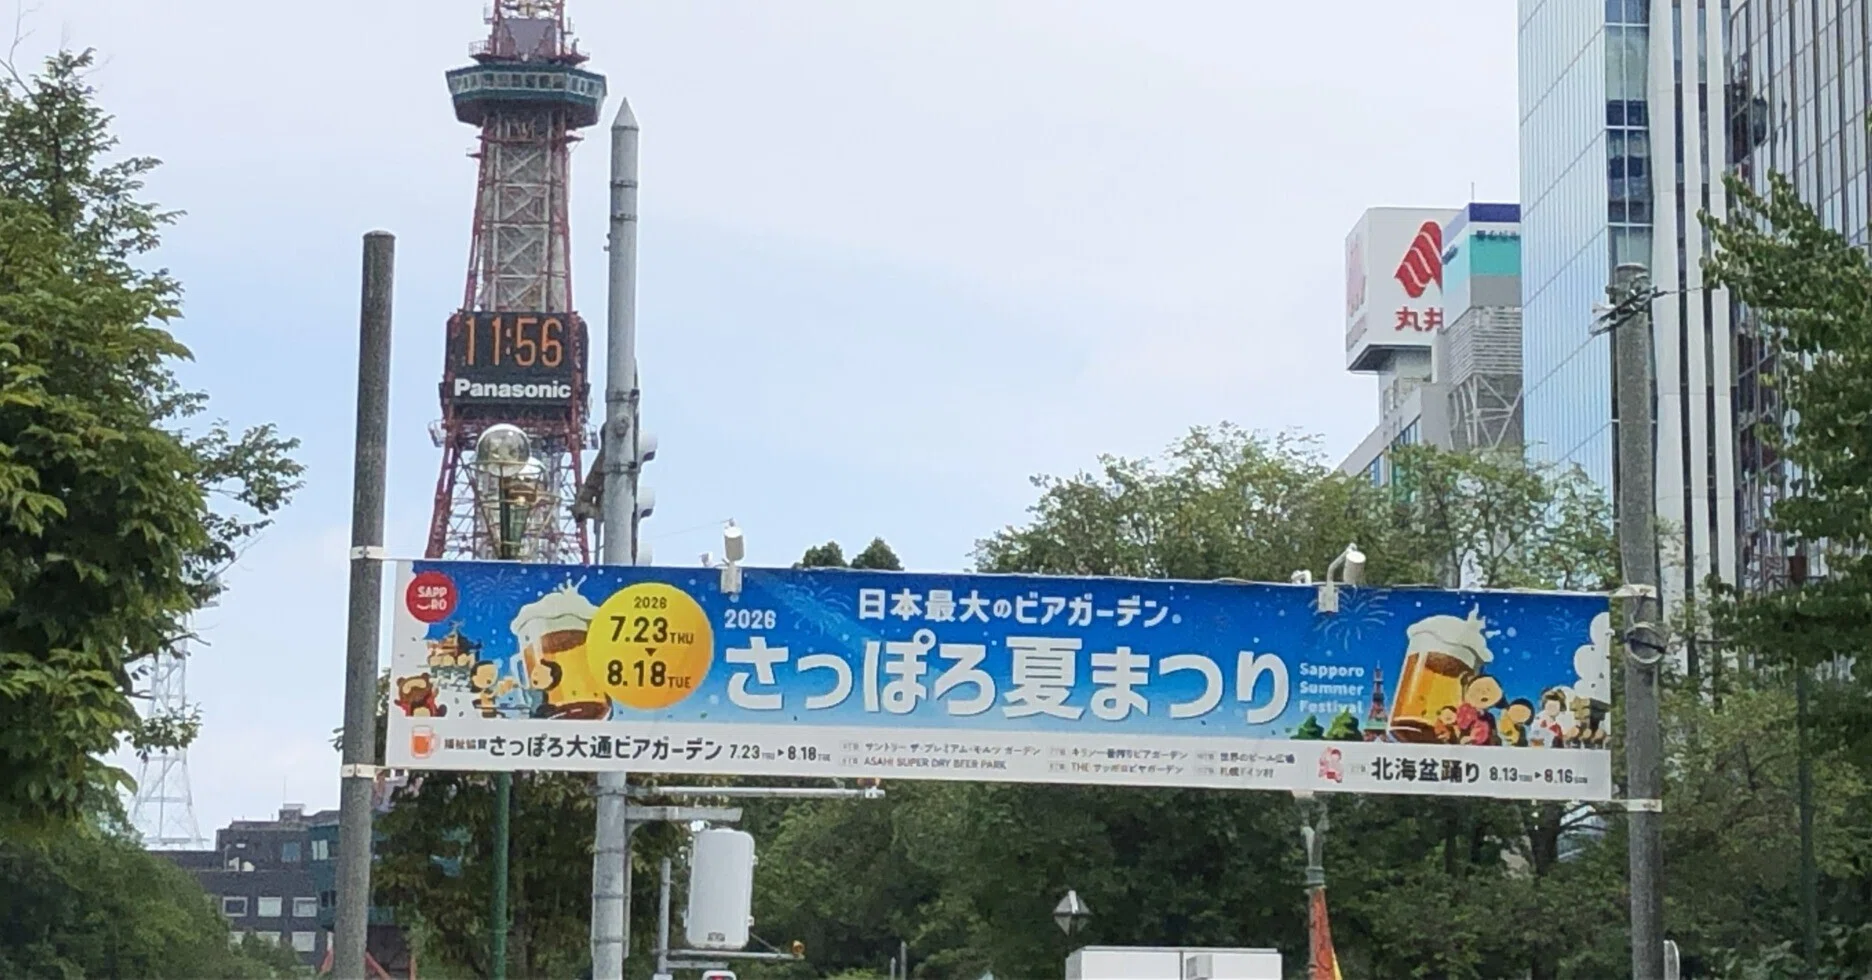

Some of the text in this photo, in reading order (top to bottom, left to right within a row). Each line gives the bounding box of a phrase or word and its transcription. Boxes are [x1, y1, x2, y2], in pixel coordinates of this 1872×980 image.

[464, 316, 563, 368] 11:56
[454, 378, 572, 399] Panasonic
[417, 585, 448, 598] SAPP
[859, 588, 1169, 628] 日本最大のビアガーデン
[724, 608, 777, 630] 2026
[610, 616, 694, 645] 7.23 THU
[607, 659, 692, 689] 8.18 TUE
[725, 628, 1290, 724] さっぽろ夏まつり
[1299, 662, 1365, 680] Sapporo
[1299, 680, 1365, 696] Summer
[1299, 699, 1364, 714] Festival
[729, 744, 760, 760] 7.23
[787, 745, 817, 761] 8.18
[864, 757, 894, 768] ASAHI
[896, 758, 929, 769] SUPER
[931, 758, 951, 769] DRY
[980, 760, 1007, 771] PARK
[1371, 756, 1480, 784] 北海盆踊り
[1488, 766, 1518, 782] 8.13
[1543, 768, 1573, 784] 8.16
